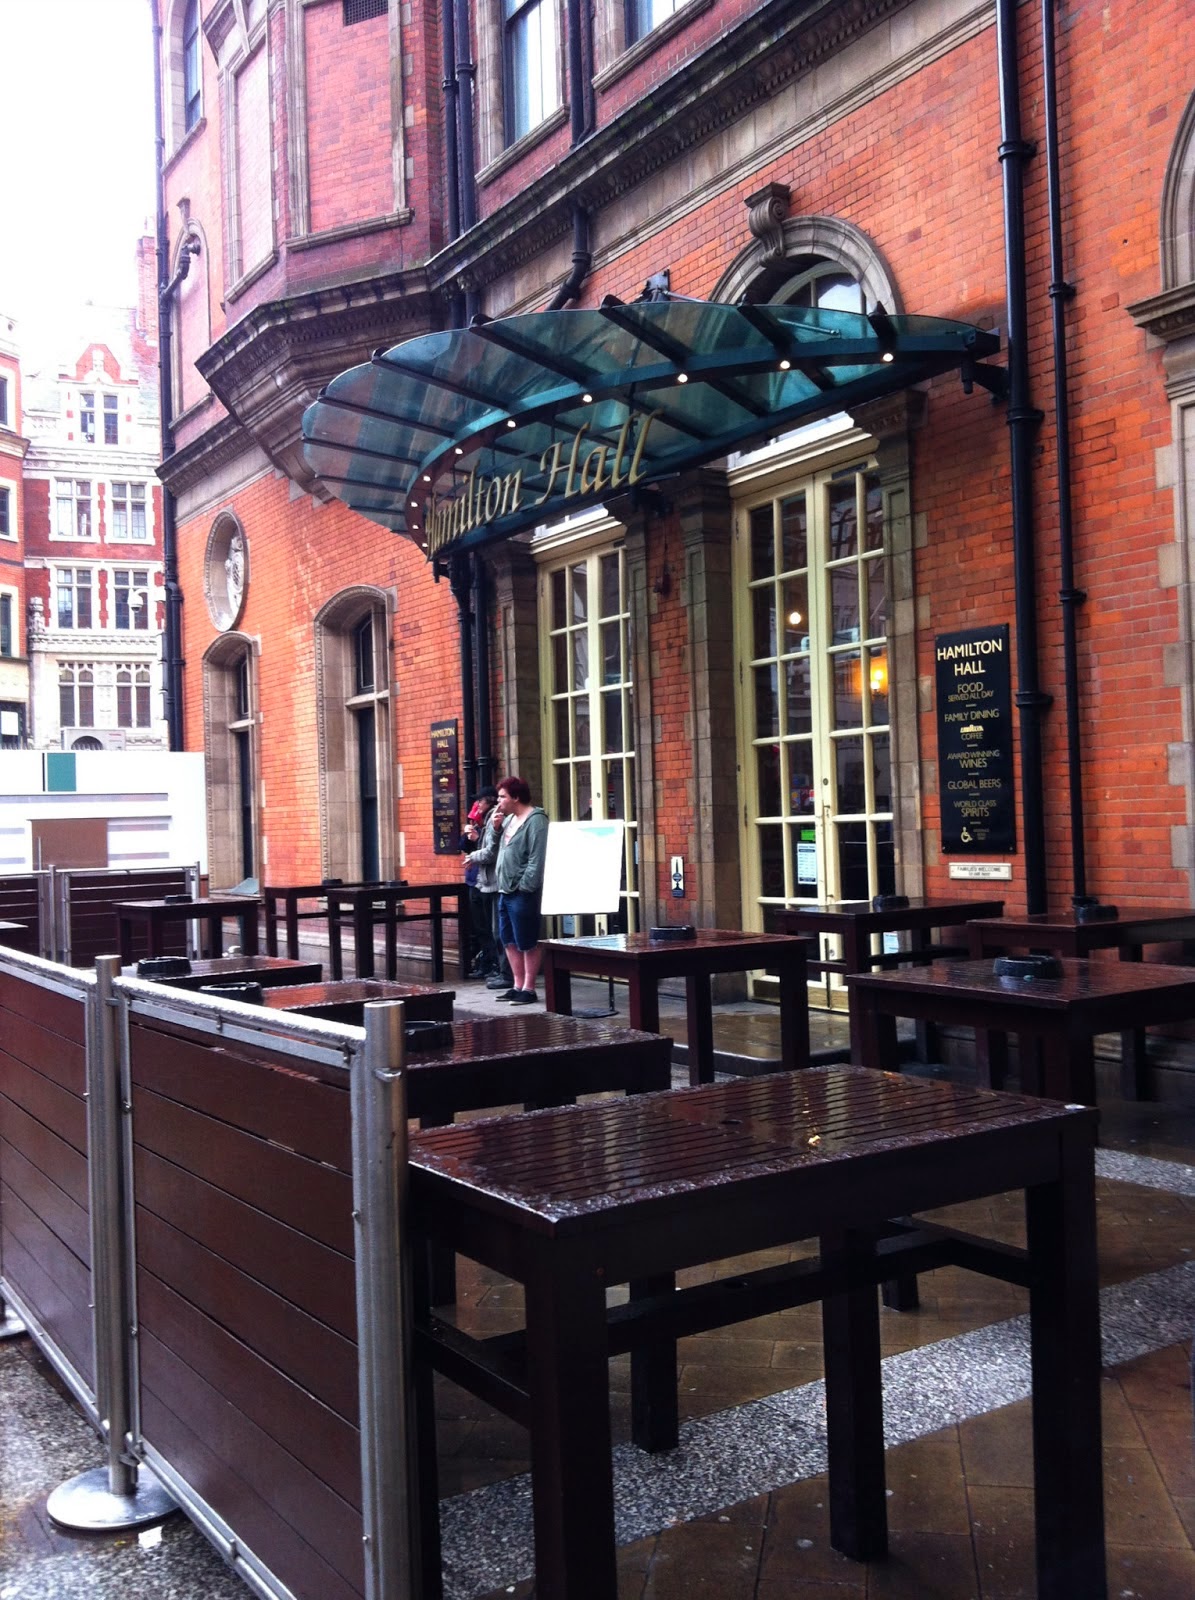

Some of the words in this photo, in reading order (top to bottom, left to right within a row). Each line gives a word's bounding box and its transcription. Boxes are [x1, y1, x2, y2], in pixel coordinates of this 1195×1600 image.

[535, 408, 664, 505] Hall
[937, 638, 1003, 661] HAMILTON
[954, 660, 986, 676] HALL
[957, 682, 984, 694] FOOD
[947, 693, 969, 702] SERVED
[969, 692, 981, 700] ALL
[981, 690, 994, 698] DAY
[944, 711, 969, 722] FAMILY
[970, 709, 1000, 721] DINING
[960, 732, 984, 740] COFFEE
[970, 749, 1000, 759] WINNING
[959, 758, 988, 768] WINES
[947, 780, 978, 790] GLOBAL
[979, 778, 1002, 789] BEERS
[961, 807, 990, 818] SPIRITS
